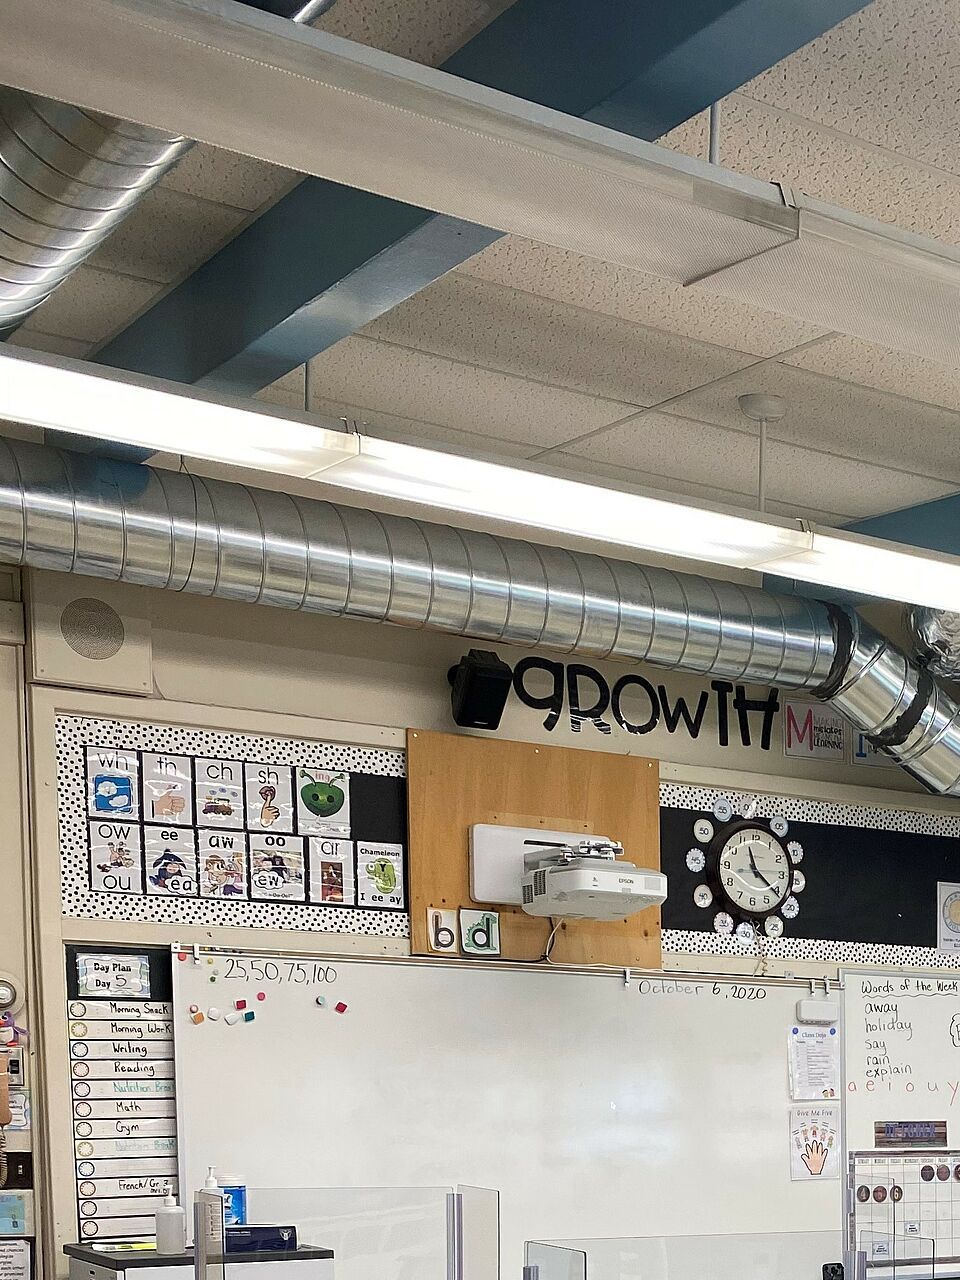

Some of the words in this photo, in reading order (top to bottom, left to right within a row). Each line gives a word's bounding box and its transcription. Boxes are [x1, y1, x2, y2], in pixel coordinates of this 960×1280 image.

[98, 751, 128, 770] wh
[206, 763, 233, 780] ch
[258, 767, 279, 785] sh
[161, 830, 179, 841] ee
[208, 835, 234, 849] aw
[265, 836, 286, 847] oo
[751, 833, 761, 842] 12
[360, 848, 400, 858] Chameleon
[775, 854, 782, 864] 2
[723, 860, 731, 870] 9
[726, 877, 734, 887] 8
[778, 870, 785, 880] 3
[171, 880, 192, 891] ea
[371, 894, 384, 902] ee
[389, 895, 401, 905] ay
[736, 890, 744, 900] 7
[749, 897, 757, 907] 6
[763, 896, 770, 905] 5
[434, 914, 454, 947] b
[472, 917, 490, 947] d
[94, 963, 109, 973] Day
[113, 963, 131, 972] Plan
[96, 979, 111, 989] Day
[116, 975, 127, 987] 5
[639, 980, 704, 995] October
[861, 980, 894, 993] Words
[900, 979, 910, 991] of
[916, 981, 932, 992] the
[110, 1002, 141, 1017] Morning
[864, 1002, 898, 1022] away
[111, 1022, 143, 1038] Morning
[865, 1017, 913, 1041] holiday
[113, 1042, 147, 1057] Writing
[865, 1039, 887, 1056] say
[866, 1055, 890, 1066] rain
[114, 1062, 154, 1076] Reading
[866, 1064, 912, 1081] explain
[848, 1081, 857, 1092] a
[866, 1080, 875, 1092] e
[905, 1082, 914, 1092] o
[927, 1081, 939, 1092] u
[947, 1081, 959, 1106] y
[116, 1102, 141, 1113] Math
[116, 1121, 139, 1135] Gym
